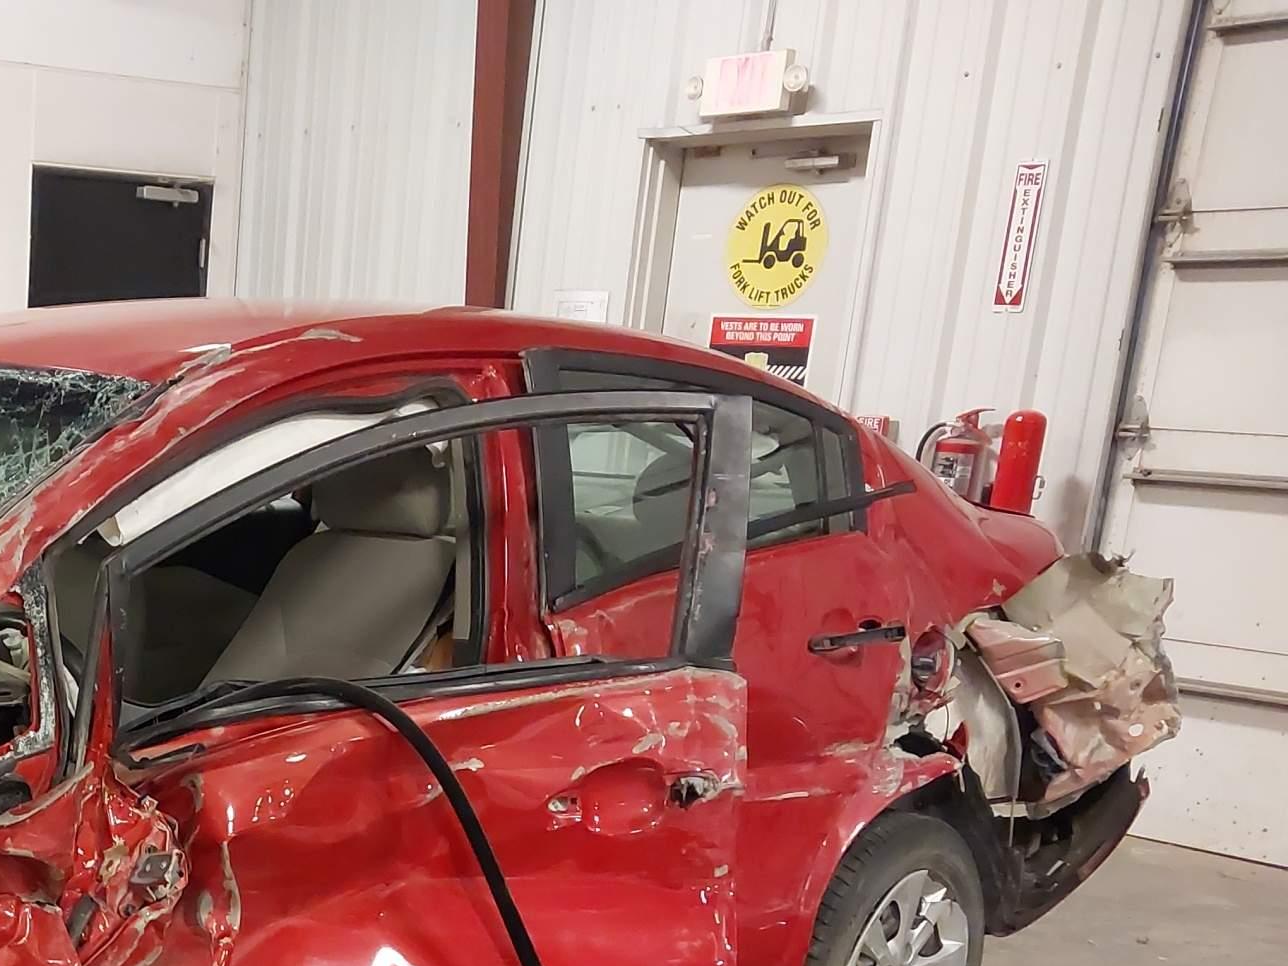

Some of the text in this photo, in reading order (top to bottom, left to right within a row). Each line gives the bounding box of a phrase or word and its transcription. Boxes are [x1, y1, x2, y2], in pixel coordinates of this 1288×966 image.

[1018, 172, 1042, 186] FIRE
[736, 190, 821, 231] WATCH OUT FOR
[1005, 189, 1032, 297] EXTINGUISHER
[730, 263, 814, 303] FORK LIFT TRUCKS
[720, 321, 805, 333] VESTS ARE TO BE WORN
[725, 331, 797, 342] BEYOND THIS POINT
